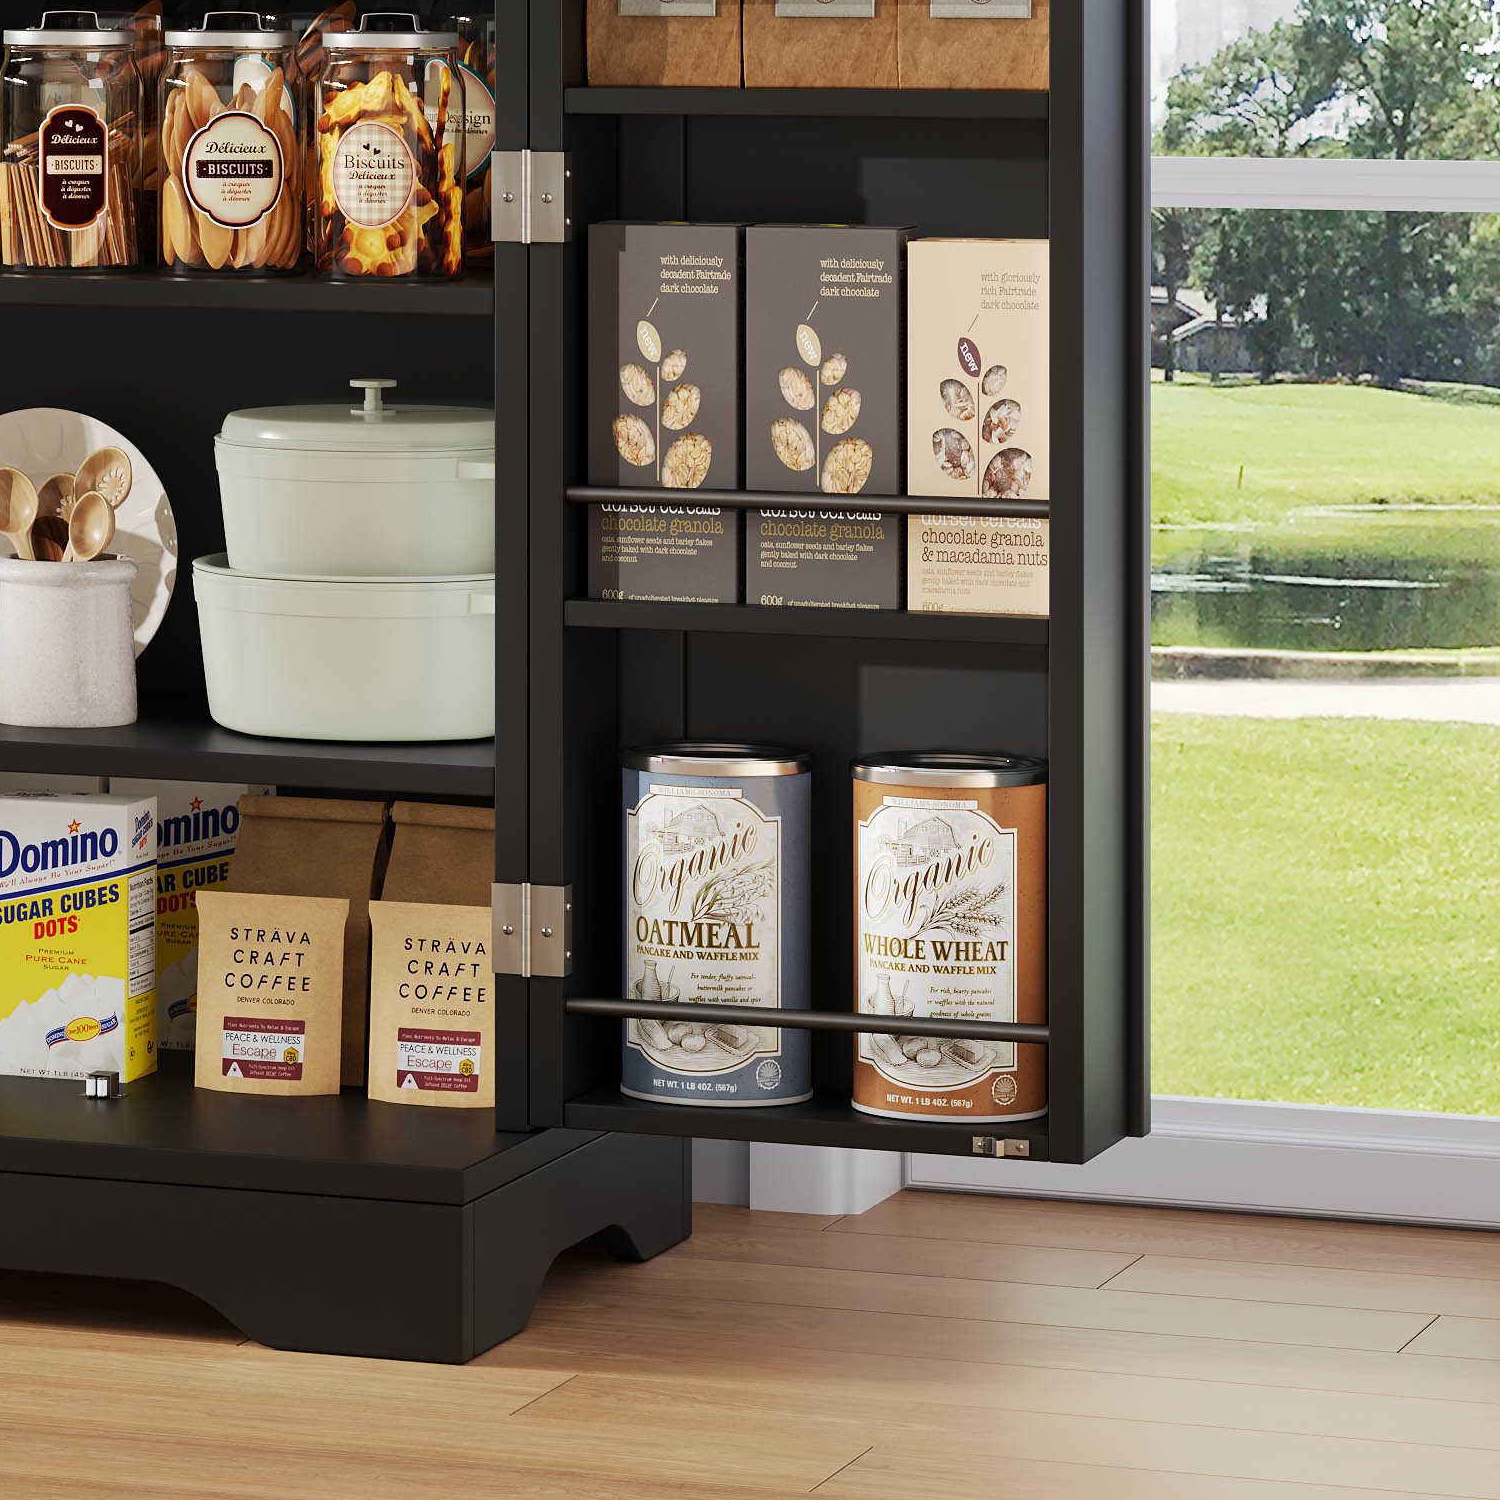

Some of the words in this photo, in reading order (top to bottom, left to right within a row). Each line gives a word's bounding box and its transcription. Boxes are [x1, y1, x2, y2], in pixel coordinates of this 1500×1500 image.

[50, 133, 98, 145] Délicieux
[206, 141, 267, 155] Délicieux
[55, 160, 95, 171] BISCUITS
[209, 162, 263, 176] BISCUITS
[344, 154, 405, 171] Biscuits
[349, 171, 395, 181] Délicieux
[660, 255, 678, 267] with
[680, 254, 723, 269] deliciously
[660, 268, 694, 280] decadent
[696, 269, 731, 281] Fairtrade
[660, 283, 679, 294] dark
[681, 283, 718, 295] chocolate
[639, 328, 658, 357] new
[798, 330, 818, 361] new
[959, 341, 978, 373] new
[602, 515, 665, 534] chocolate
[670, 517, 724, 538] granola
[760, 520, 825, 540] chocolate
[830, 523, 884, 544] granola
[922, 528, 986, 547] chocolate
[991, 530, 1044, 550] granola
[922, 547, 934, 562] &
[939, 547, 1012, 565] macadamia
[1018, 550, 1048, 566] nuts
[633, 821, 758, 910] Organic
[865, 832, 995, 924] Organic
[61, 883, 119, 912] CUBES
[34, 916, 78, 940] DOTS
[231, 927, 311, 945] STRÄVA
[636, 916, 760, 948] OATMEAL
[405, 938, 486, 955] STRÄVA
[637, 945, 670, 957] PANCAKE
[673, 950, 693, 959] AND
[696, 951, 737, 961] WAFFLE
[739, 951, 758, 961] MIX
[864, 932, 926, 961] WHOLE
[931, 940, 1008, 962] WHEAT
[25, 955, 54, 963] PURE
[58, 957, 87, 965] CANE
[234, 950, 304, 967] CRAFT
[408, 960, 480, 977] CRAFT
[225, 973, 310, 991] COFFEE
[399, 983, 486, 1002] COFFEE
[226, 1033, 250, 1042] PEACE
[252, 1034, 259, 1043] &
[261, 1035, 300, 1044] WELLNESS
[232, 1044, 276, 1059] Escape
[285, 1055, 297, 1063] CBD
[407, 1055, 453, 1071] Escape
[653, 1079, 665, 1087] NET
[668, 1080, 680, 1089] WT.
[681, 1081, 685, 1089] 1
[687, 1081, 696, 1090] LB
[715, 1083, 737, 1093] (567g)
